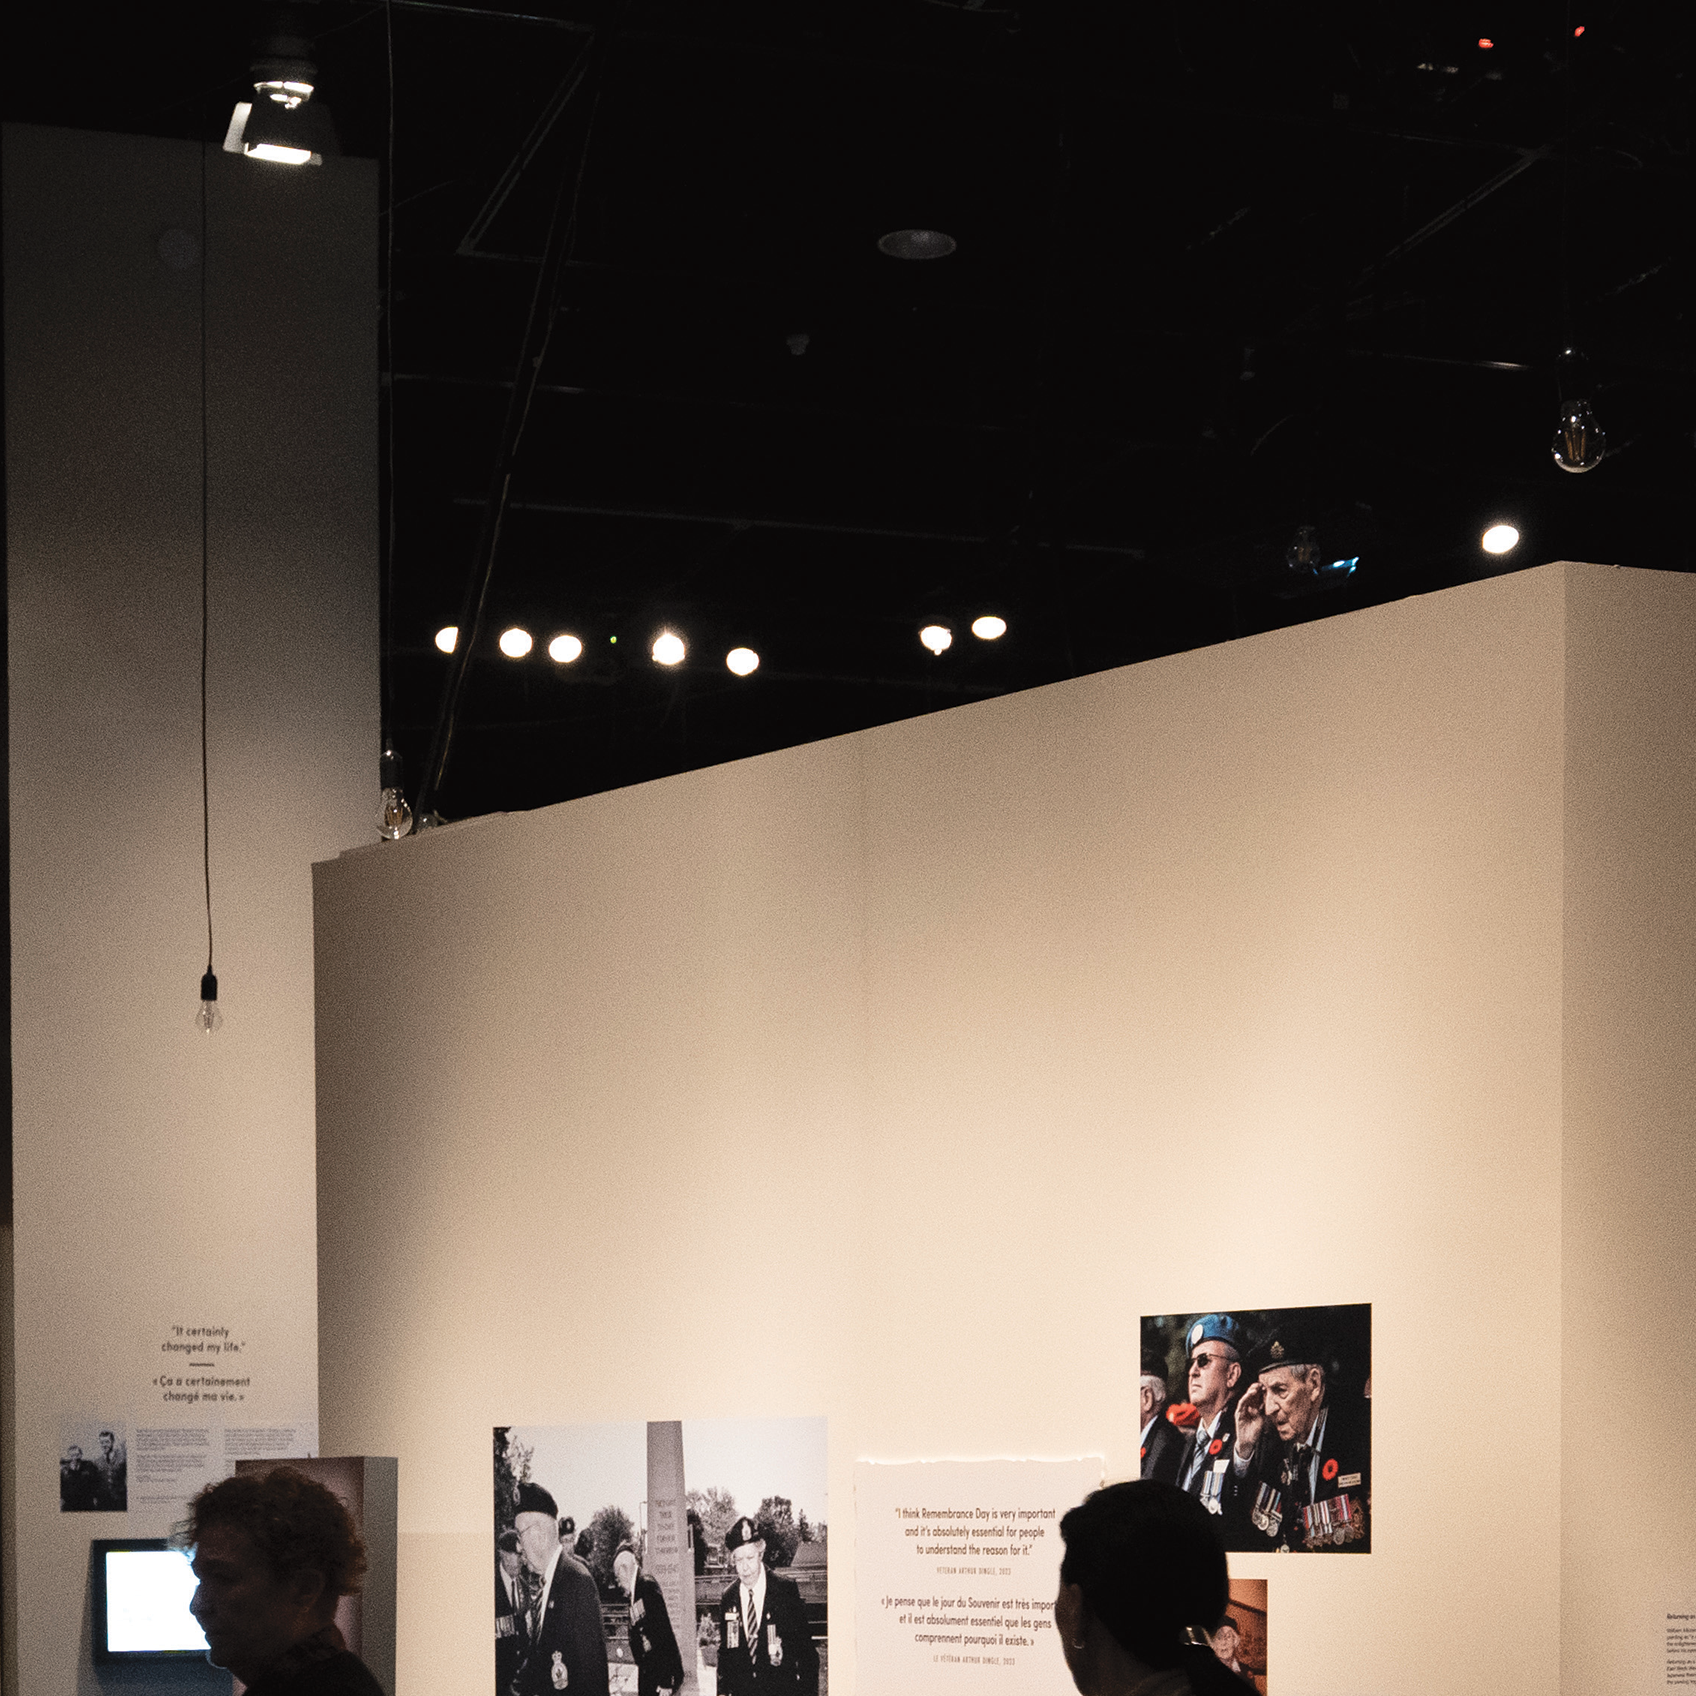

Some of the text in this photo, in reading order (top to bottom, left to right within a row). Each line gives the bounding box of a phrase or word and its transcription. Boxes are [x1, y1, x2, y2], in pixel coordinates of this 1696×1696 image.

[186, 1325, 229, 1339] certainly
[162, 1341, 203, 1355] changed
[207, 1344, 220, 1355] my
[160, 1375, 173, 1388] Ça
[186, 1376, 250, 1386] certainement
[163, 1390, 199, 1404] changé
[221, 1391, 236, 1401] vie.
[903, 1508, 919, 1519] think
[922, 1508, 973, 1519] Remembrance
[976, 1508, 990, 1522] Day
[992, 1508, 998, 1519] is
[1000, 1510, 1016, 1522] very
[1018, 1508, 1055, 1522] important
[905, 1526, 919, 1537] and
[933, 1525, 970, 1540] absolutely
[972, 1526, 1004, 1537] essential
[1007, 1526, 1017, 1537] for
[1019, 1526, 1044, 1540] people
[917, 1545, 923, 1554] to
[926, 1543, 967, 1555] understand
[969, 1544, 980, 1555] the
[983, 1546, 1008, 1555] reason
[1010, 1544, 1021, 1555] for
[959, 1567, 977, 1575] ARTHUR
[886, 1595, 893, 1609] Je
[895, 1597, 915, 1609] pense
[918, 1598, 930, 1610] que
[933, 1596, 939, 1606] le
[941, 1596, 955, 1610] jour
[957, 1596, 966, 1607] du
[968, 1597, 1000, 1609] Souvenir
[1002, 1599, 1013, 1609] est
[1016, 1598, 1030, 1610] très
[1032, 1598, 1055, 1613] impor
[900, 1613, 1051, 1631] et il est absolument essentiel que les gens
[915, 1633, 962, 1646] comprennent
[964, 1634, 997, 1647] pourquoi
[999, 1634, 1003, 1645] il
[1005, 1634, 1029, 1646] existe.
[962, 1656, 980, 1664] ARTHUR
